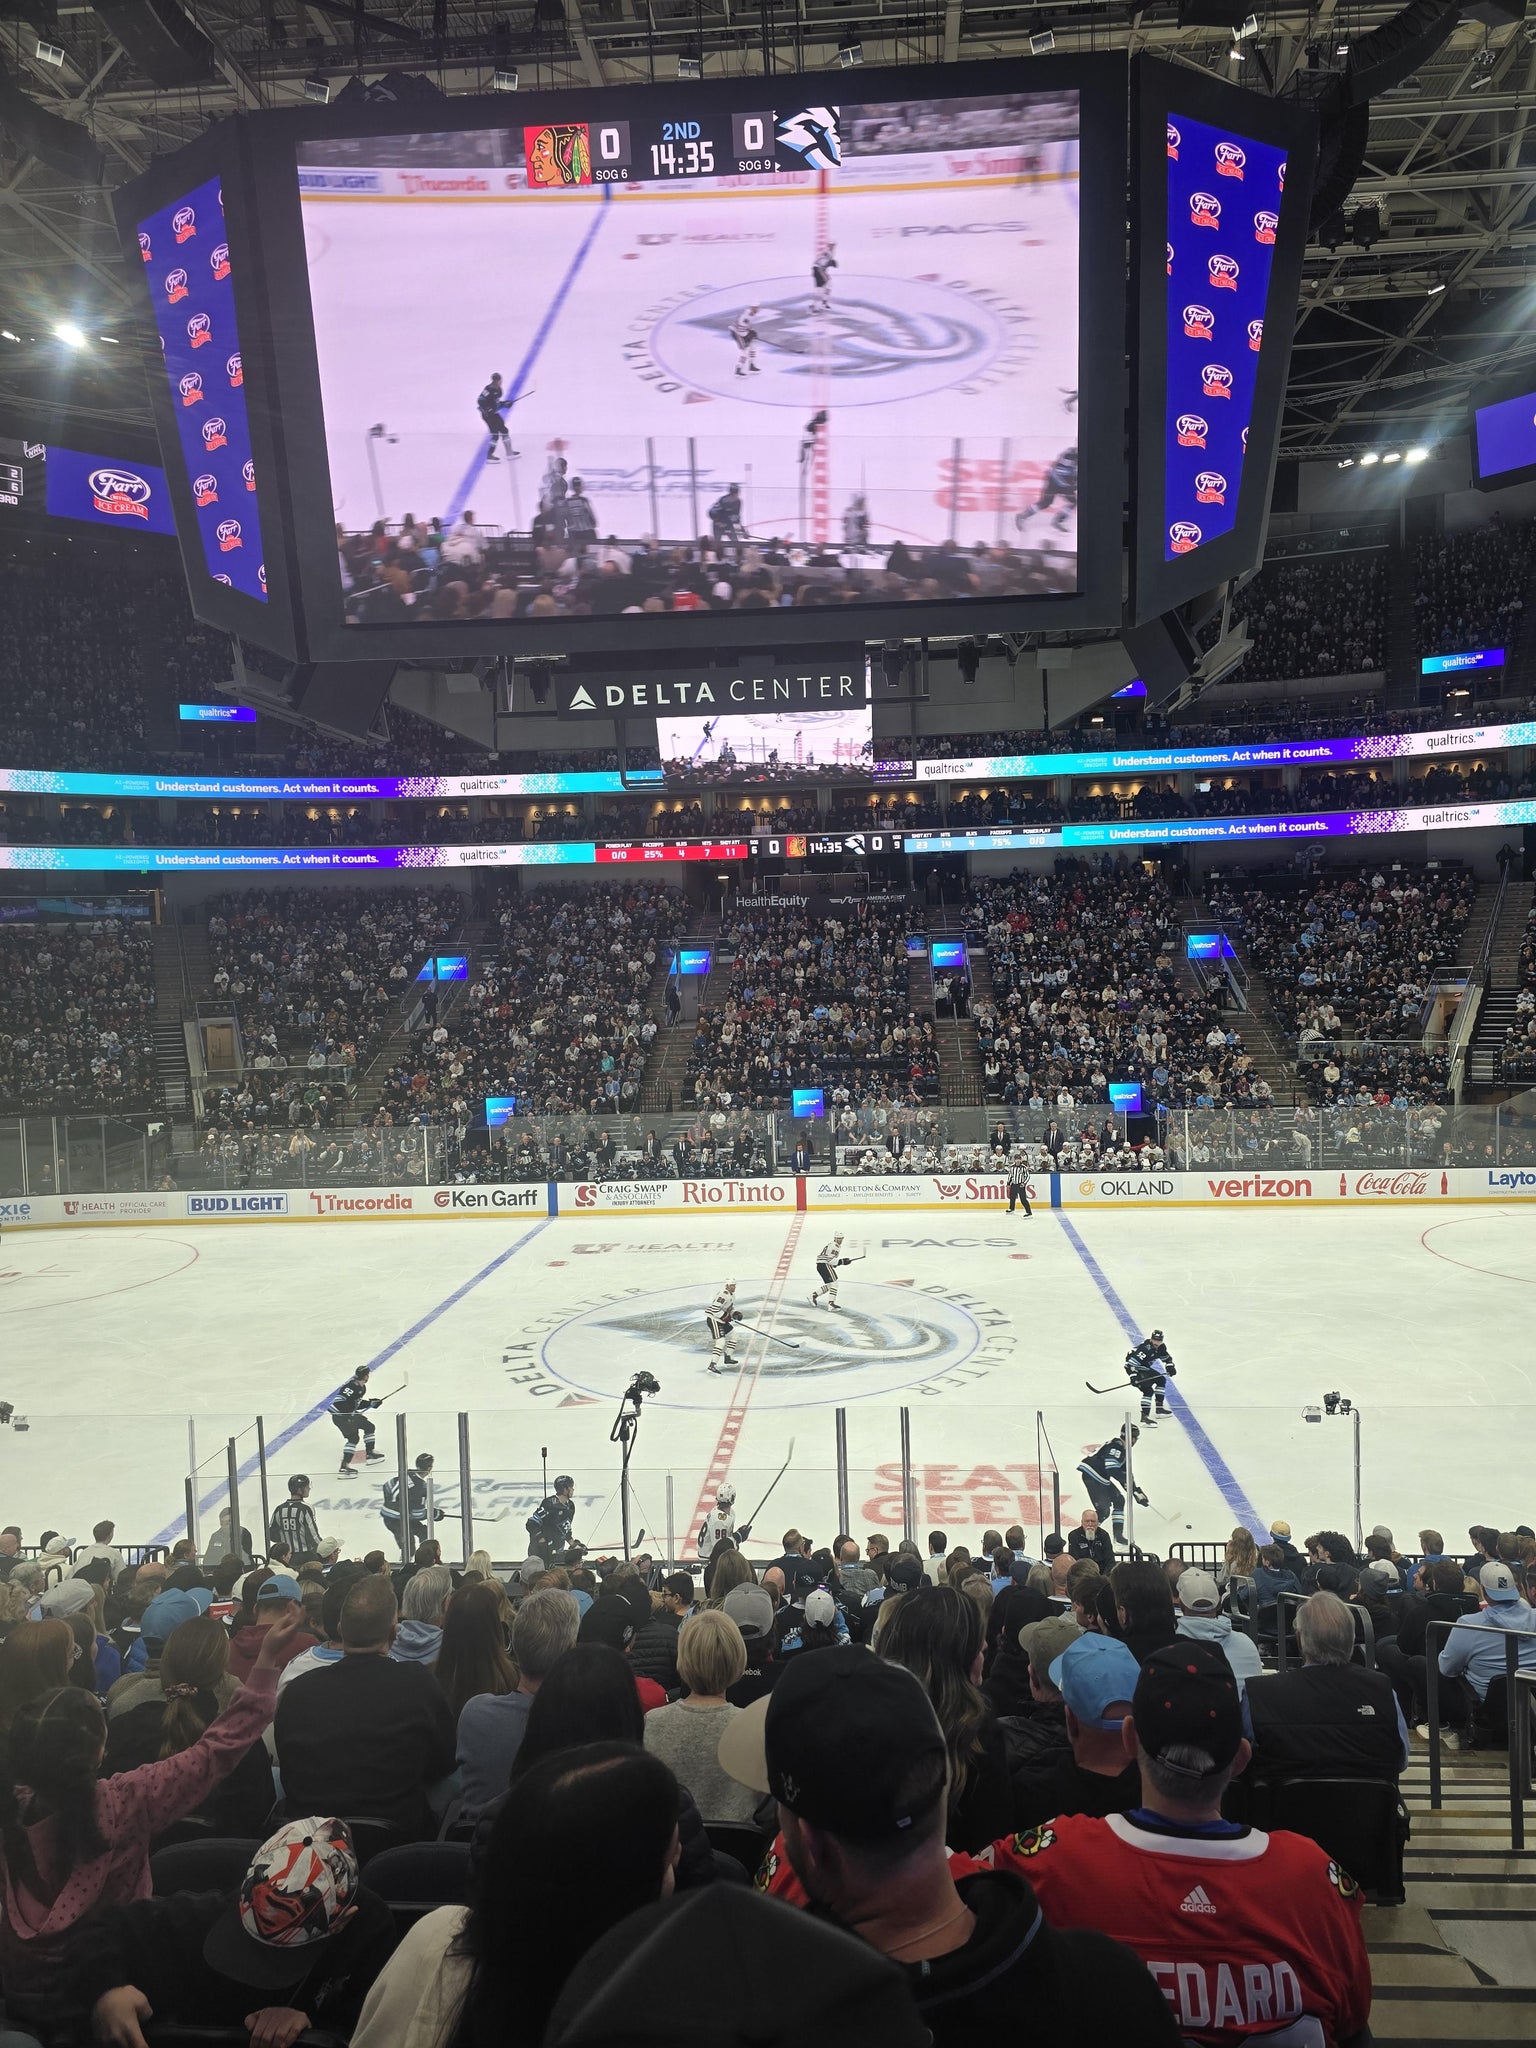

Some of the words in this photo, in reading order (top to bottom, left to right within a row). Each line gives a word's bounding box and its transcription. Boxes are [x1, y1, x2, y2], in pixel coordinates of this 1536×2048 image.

[663, 121, 700, 141] 2ND
[744, 118, 764, 150] 0
[600, 128, 621, 160] 0
[650, 141, 714, 176] 14:35
[738, 161, 762, 172] SOG
[763, 160, 771, 171] 9
[595, 169, 618, 181] SOG
[620, 168, 628, 180] 6
[10, 469, 18, 478] 2
[11, 482, 19, 491] 6
[98, 472, 143, 496] Farr
[98, 502, 112, 511] ICE
[114, 503, 144, 515] CREAM
[605, 681, 715, 707] DELTA
[729, 675, 854, 702] CENTER
[1113, 755, 1172, 767] Understand
[1174, 752, 1231, 765] customers.
[1233, 751, 1250, 761] Act
[1252, 750, 1281, 760] when
[1282, 748, 1292, 758] it
[1294, 747, 1333, 758] counts.
[155, 781, 220, 793] Understand
[222, 783, 281, 794] customers.
[283, 784, 300, 794] Act
[303, 783, 331, 793] when
[332, 782, 341, 793] it
[343, 783, 379, 794] counts.
[1109, 828, 1169, 839] Understand
[1170, 826, 1226, 837] customers.
[1229, 825, 1246, 834] Act
[1248, 823, 1277, 833] when
[1279, 822, 1288, 832] it
[1289, 821, 1329, 831] counts.
[769, 840, 780, 854] 0
[872, 837, 882, 850] 0
[894, 841, 900, 849] 9
[916, 841, 928, 849] 23
[941, 840, 951, 848] 14
[992, 838, 1011, 847] 75%
[1029, 837, 1045, 845] 0/0
[644, 850, 663, 858] 25%
[678, 849, 685, 857] 4
[704, 848, 711, 856] 7
[725, 848, 736, 856] 11
[751, 846, 758, 854] 6
[809, 842, 842, 854] 14:35
[155, 854, 220, 865] Understand
[222, 854, 281, 865] customers.
[283, 854, 300, 864] Act
[303, 854, 331, 864] when
[332, 853, 341, 864] it
[343, 854, 379, 864] counts.
[611, 851, 627, 859] 0/0
[736, 896, 808, 908] HealthEquity
[599, 1184, 631, 1194] CRAIG
[634, 1183, 668, 1193] SWAPP
[834, 1184, 874, 1192] MORETON
[882, 1183, 921, 1192] COMPANY
[1101, 1180, 1174, 1196] OKLAND
[1207, 1174, 1312, 1197] verizon
[1356, 1171, 1431, 1195] Coca-Cola
[325, 1194, 413, 1211] Trucordia
[452, 1190, 488, 1207] Ken
[492, 1190, 537, 1207] Garff
[613, 1192, 662, 1201] ASSOCIATES
[81, 1202, 115, 1211] HEALTH
[191, 1198, 230, 1212] BUD
[232, 1197, 285, 1211] LIGHT
[626, 1242, 735, 1250] HEALTH
[881, 1238, 1018, 1248] PACS
[522, 1287, 650, 1334] CENTER
[920, 1285, 1012, 1327] DELTA
[1137, 1351, 1147, 1360] 52
[502, 1341, 564, 1396] DELTA
[907, 1335, 1018, 1396] CENTER
[342, 1387, 354, 1396] 92
[874, 1463, 1055, 1491] SEAT
[861, 1494, 1082, 1527] GEEK
[283, 1519, 297, 1531] 89
[1180, 1902, 1217, 1914] adidas
[1147, 1960, 1303, 2028] EDARD
